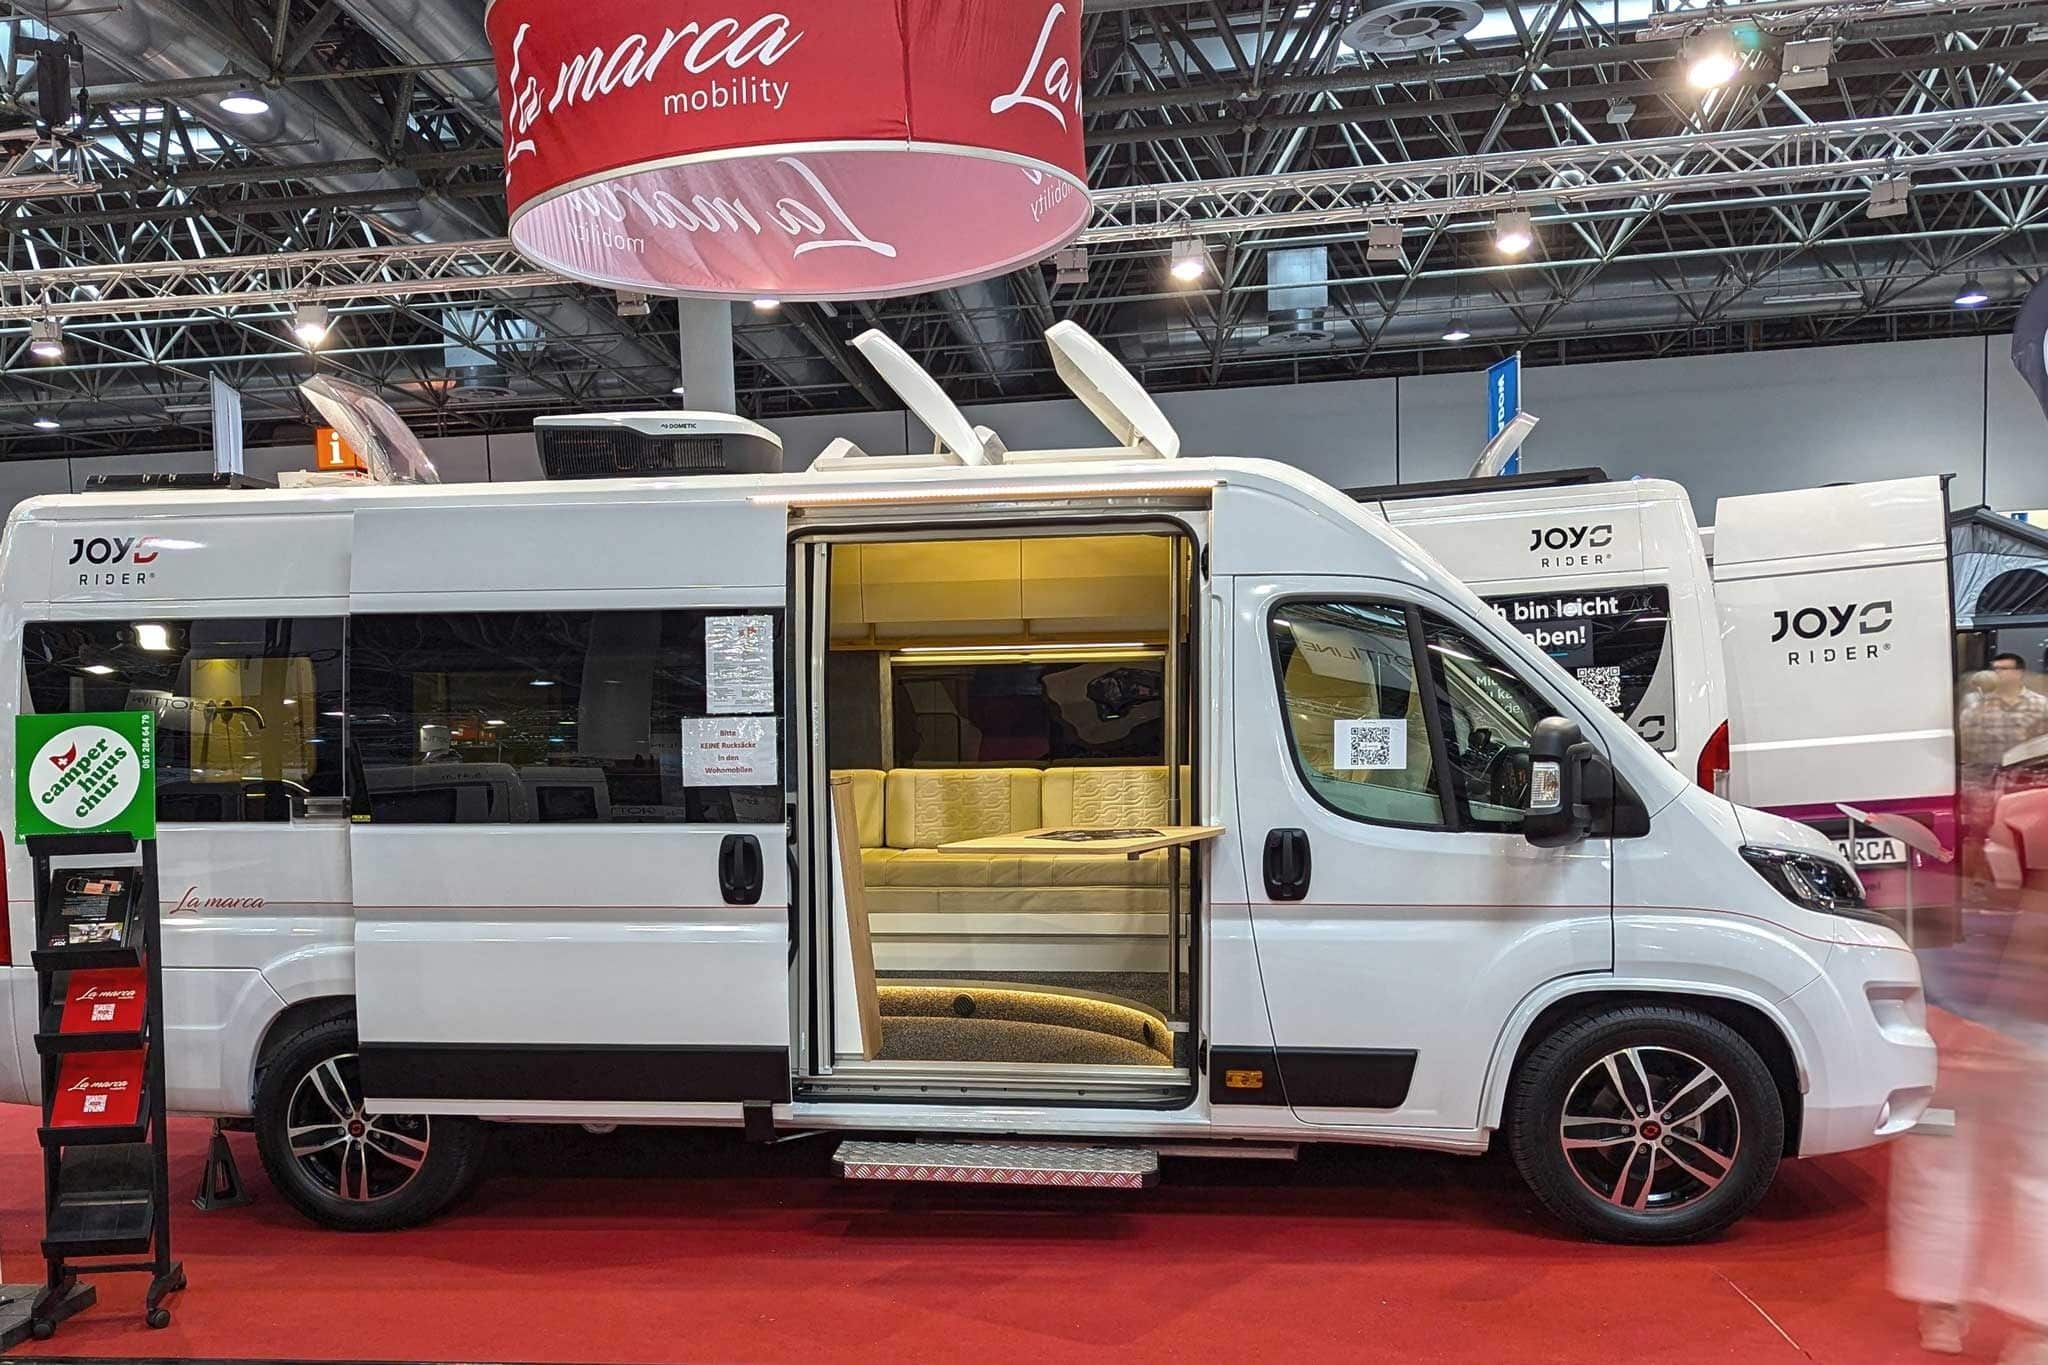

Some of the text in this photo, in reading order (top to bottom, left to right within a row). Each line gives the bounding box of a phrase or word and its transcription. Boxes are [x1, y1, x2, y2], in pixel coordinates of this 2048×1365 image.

[548, 13, 804, 114] marca
[990, 3, 1073, 134] La
[664, 76, 790, 116] mobility
[1514, 601, 1549, 620] bin
[1557, 597, 1619, 618] leicht
[41, 738, 109, 805] camper
[77, 747, 128, 793] huus
[75, 774, 119, 818] chur
[1838, 840, 1897, 862] ARCA
[169, 886, 265, 914] La marca
[75, 987, 98, 1001] La
[67, 1077, 88, 1091] La
